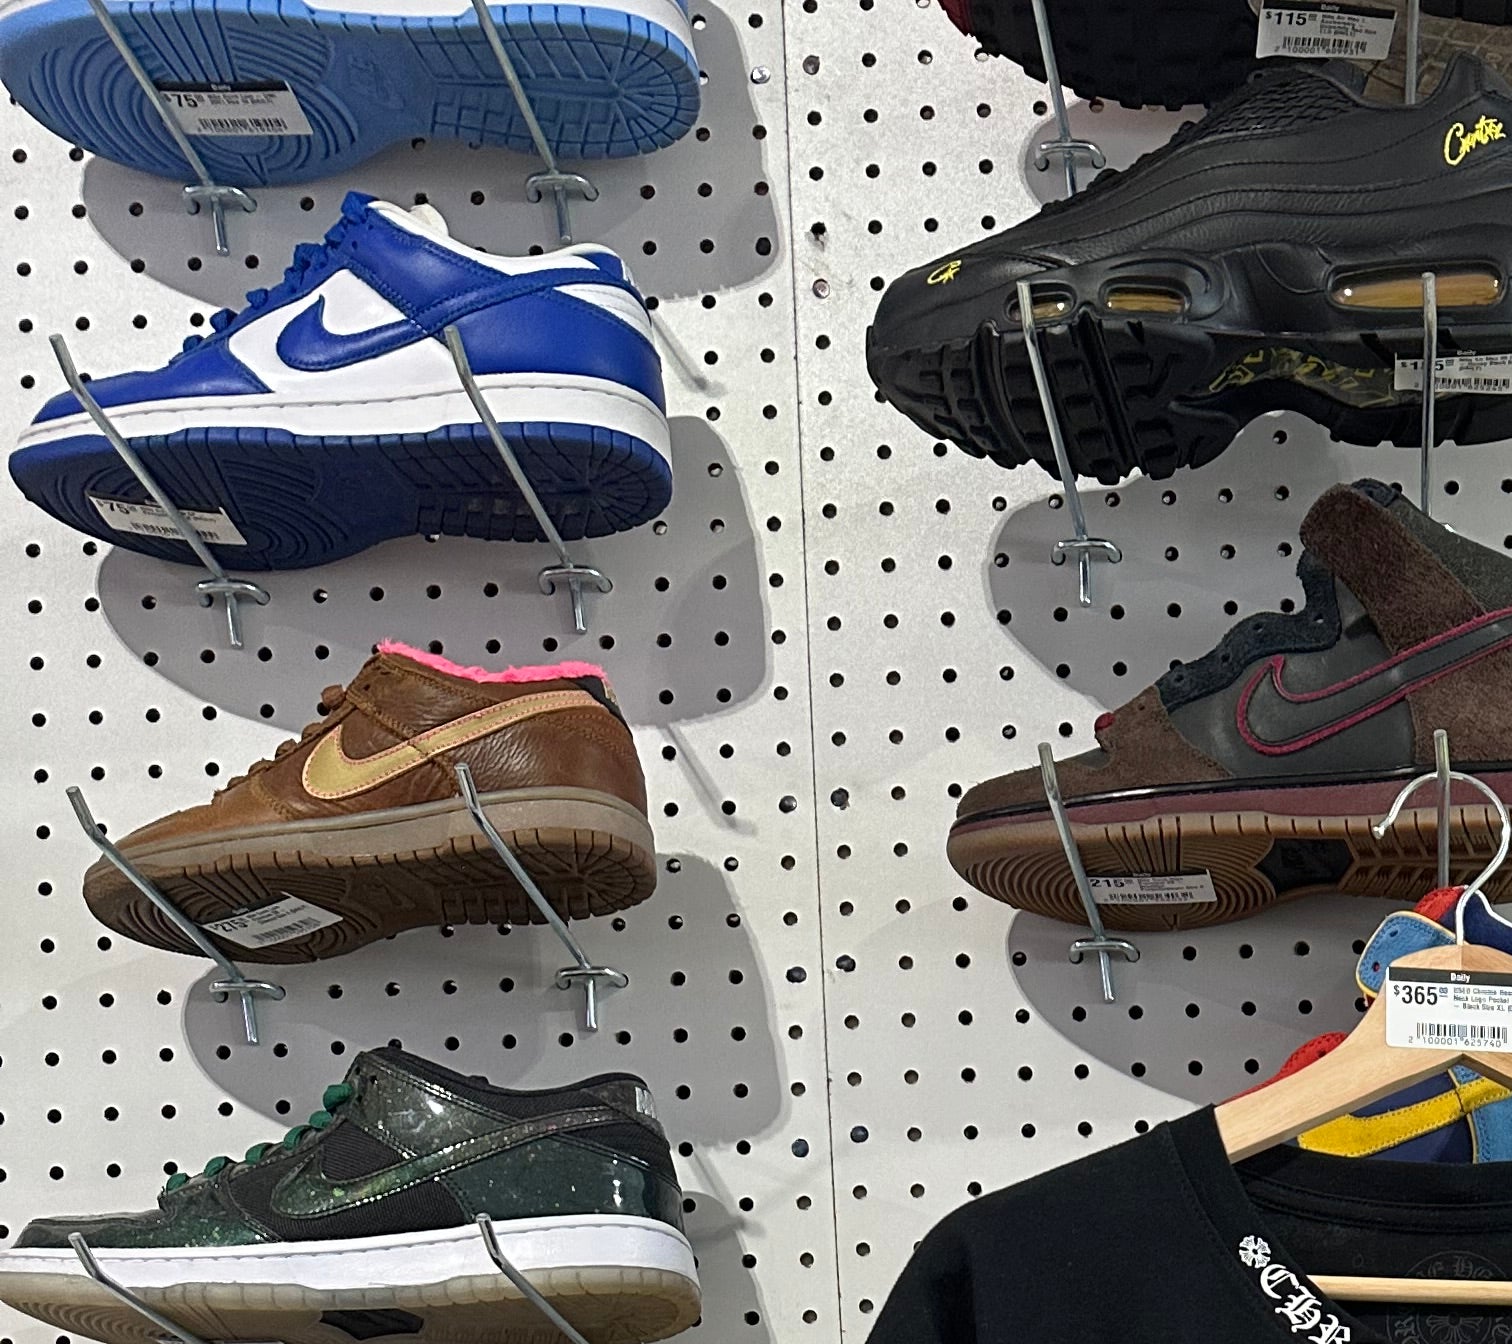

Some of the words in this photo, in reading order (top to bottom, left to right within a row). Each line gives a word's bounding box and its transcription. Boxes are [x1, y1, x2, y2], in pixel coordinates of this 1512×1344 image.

[1265, 11, 1307, 25] $115
[1401, 359, 1444, 371] $15
[1450, 972, 1471, 983] Daily
[1393, 985, 1438, 1006] $365
[1423, 1037, 1459, 1045] 100001
